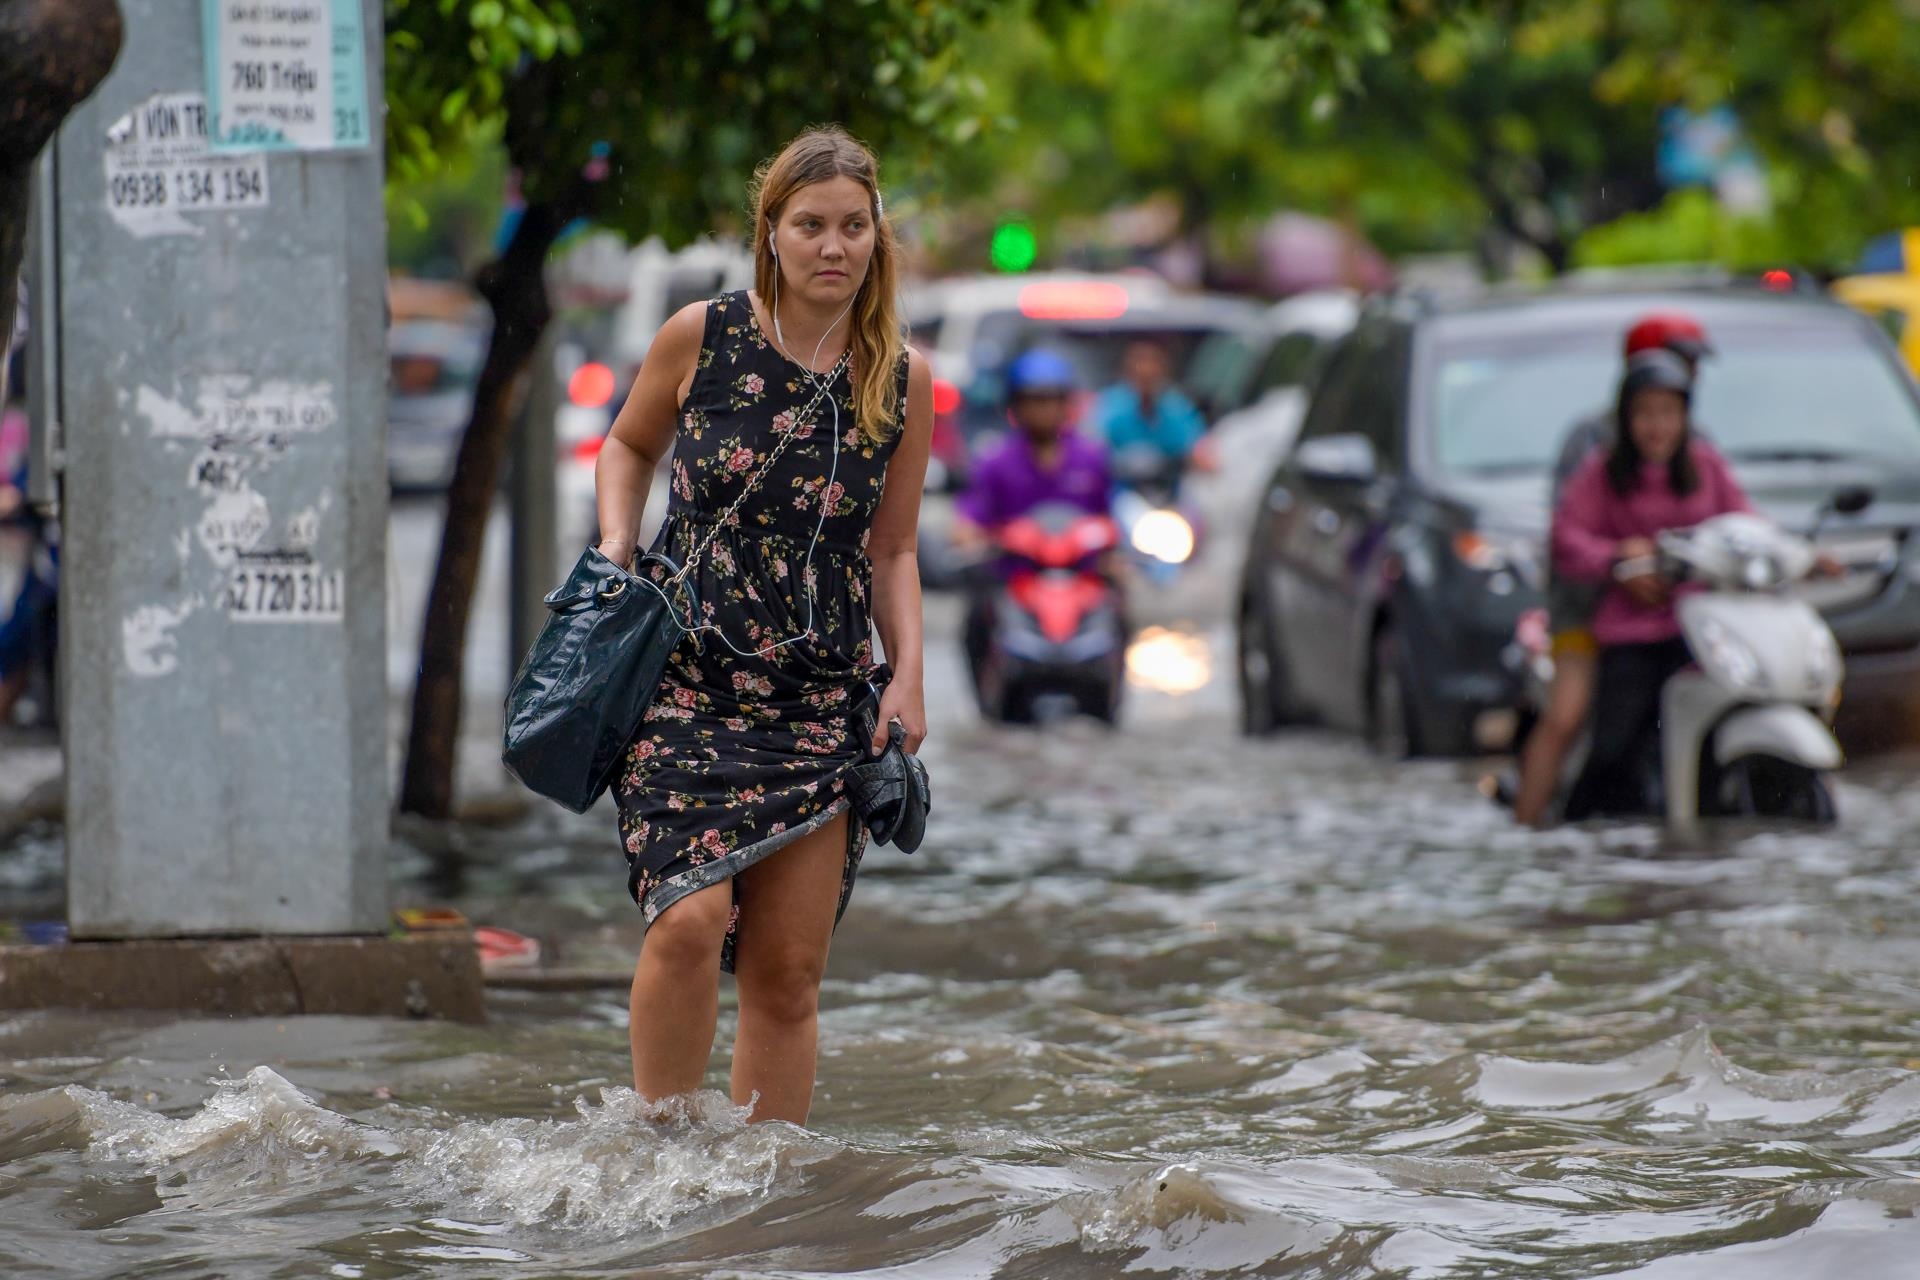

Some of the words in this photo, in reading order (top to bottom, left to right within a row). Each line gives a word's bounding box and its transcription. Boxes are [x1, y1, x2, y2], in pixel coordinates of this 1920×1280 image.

[232, 61, 267, 91] 760
[271, 59, 318, 96] Triệu
[113, 172, 166, 207] 0938
[176, 169, 214, 202] 134
[224, 168, 261, 200] 194
